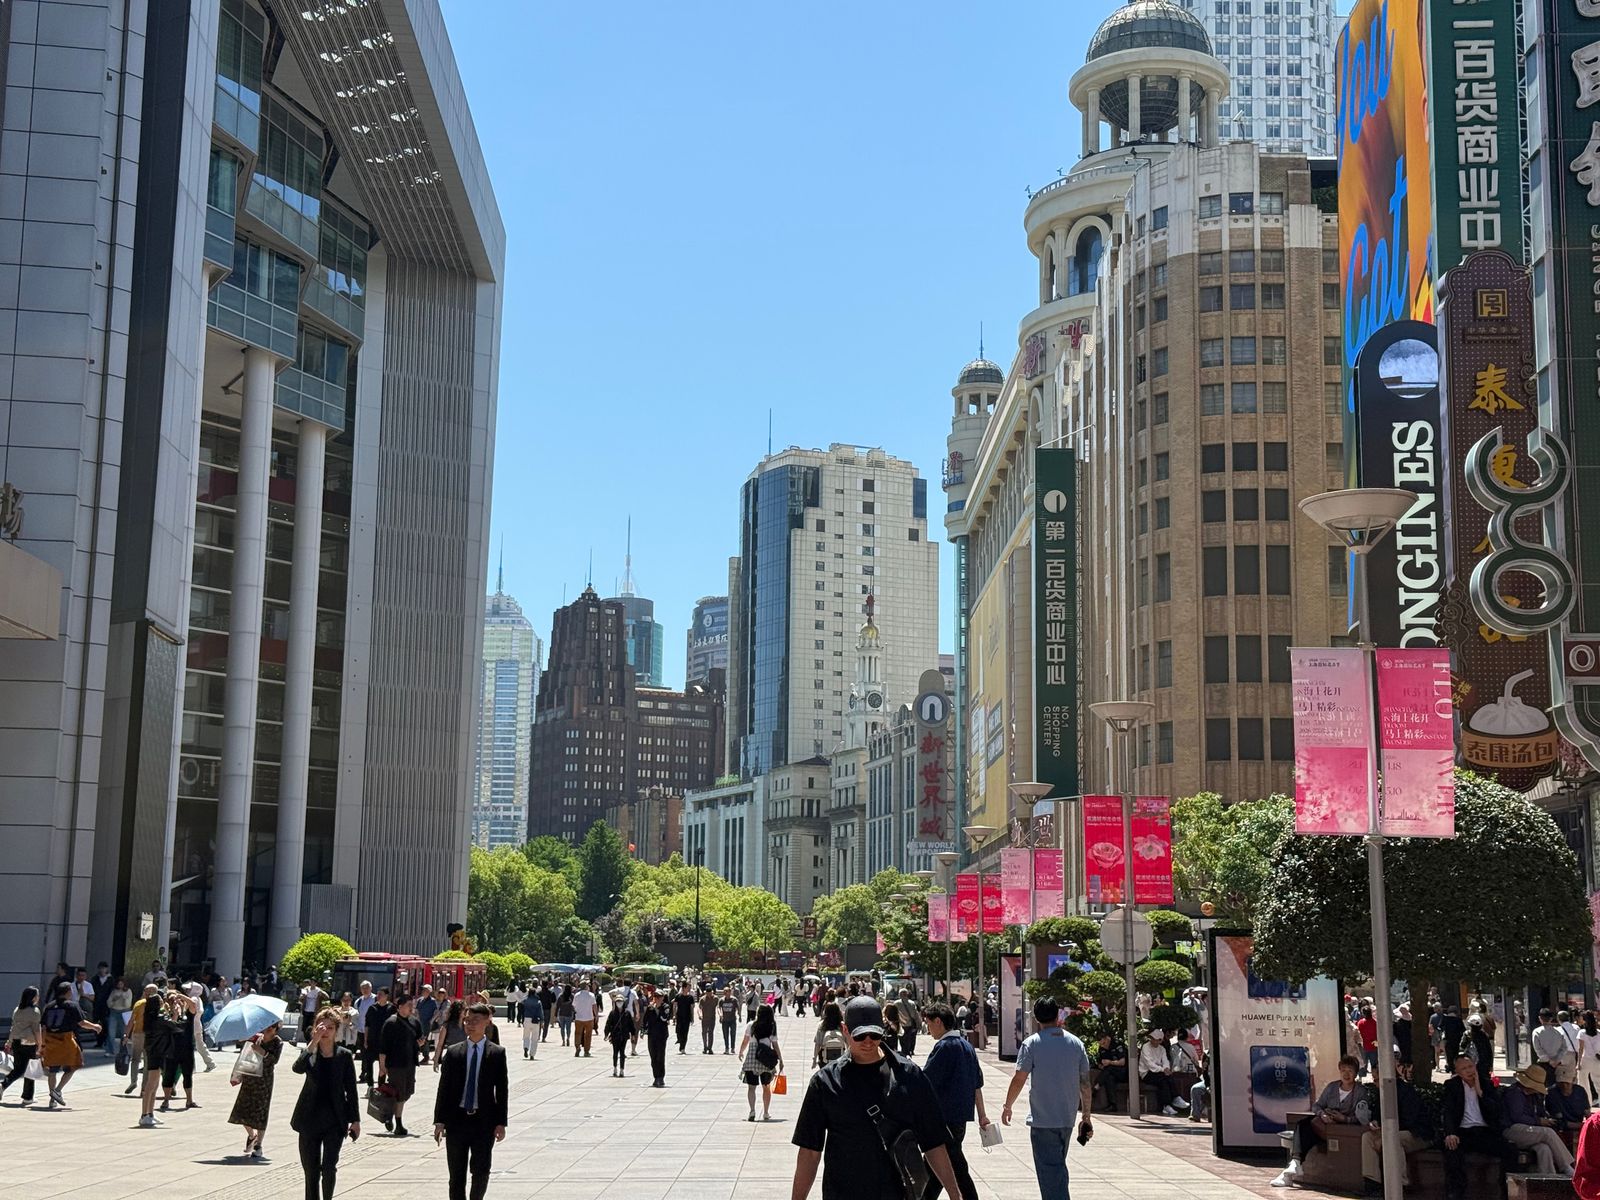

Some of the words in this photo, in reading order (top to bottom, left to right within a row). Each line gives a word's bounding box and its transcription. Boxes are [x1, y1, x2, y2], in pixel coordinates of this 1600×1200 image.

[1045, 521, 1066, 686] 第一百货商业中心
[1043, 705, 1052, 746] CENTER
[1052, 705, 1061, 758] SHOPPING
[1061, 705, 1070, 728] NO.1
[1391, 713, 1429, 723] 海上花开
[1385, 729, 1423, 739] 马上精彩
[1466, 740, 1553, 764] 泰康汤包
[919, 731, 945, 841] 新世界城
